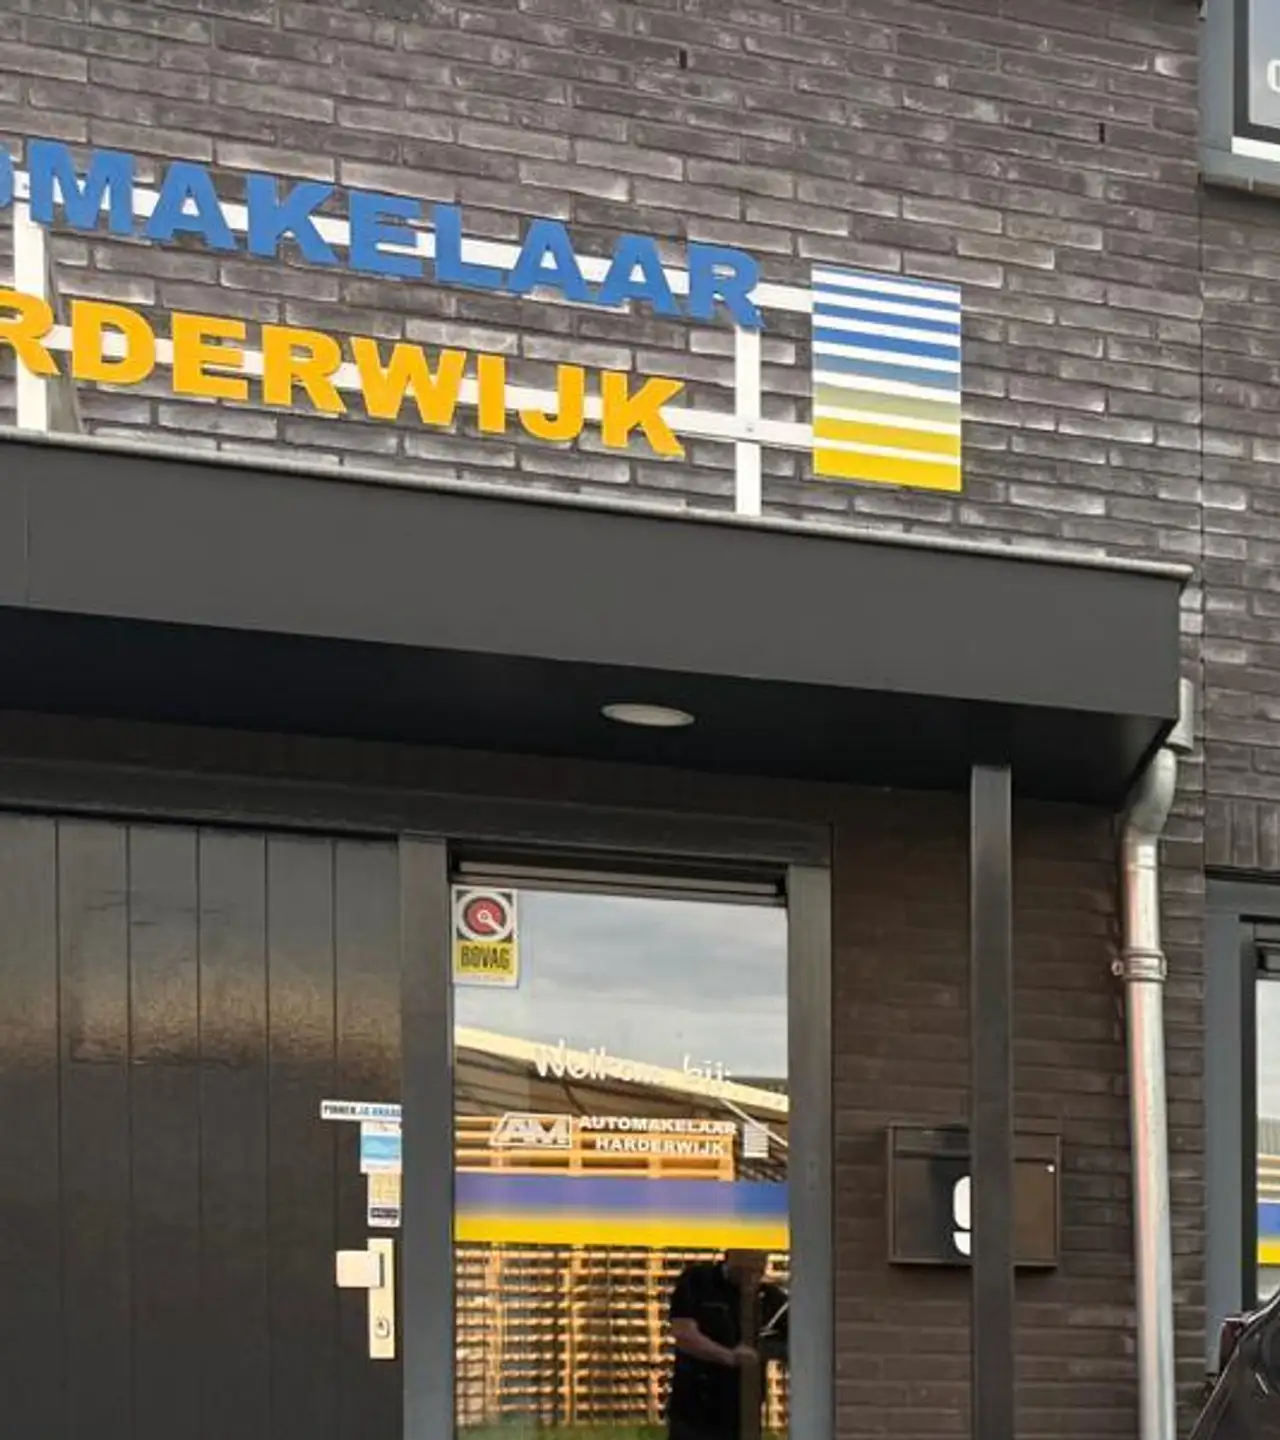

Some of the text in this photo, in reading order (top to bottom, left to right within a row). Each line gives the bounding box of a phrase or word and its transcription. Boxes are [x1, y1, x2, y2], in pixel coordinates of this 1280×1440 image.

[0, 138, 766, 329] MAKELAAR
[460, 944, 511, 971] BOVAG
[578, 1114, 738, 1135] AUTOMAKELAAR
[595, 1136, 726, 1156] HARDERWIJK
